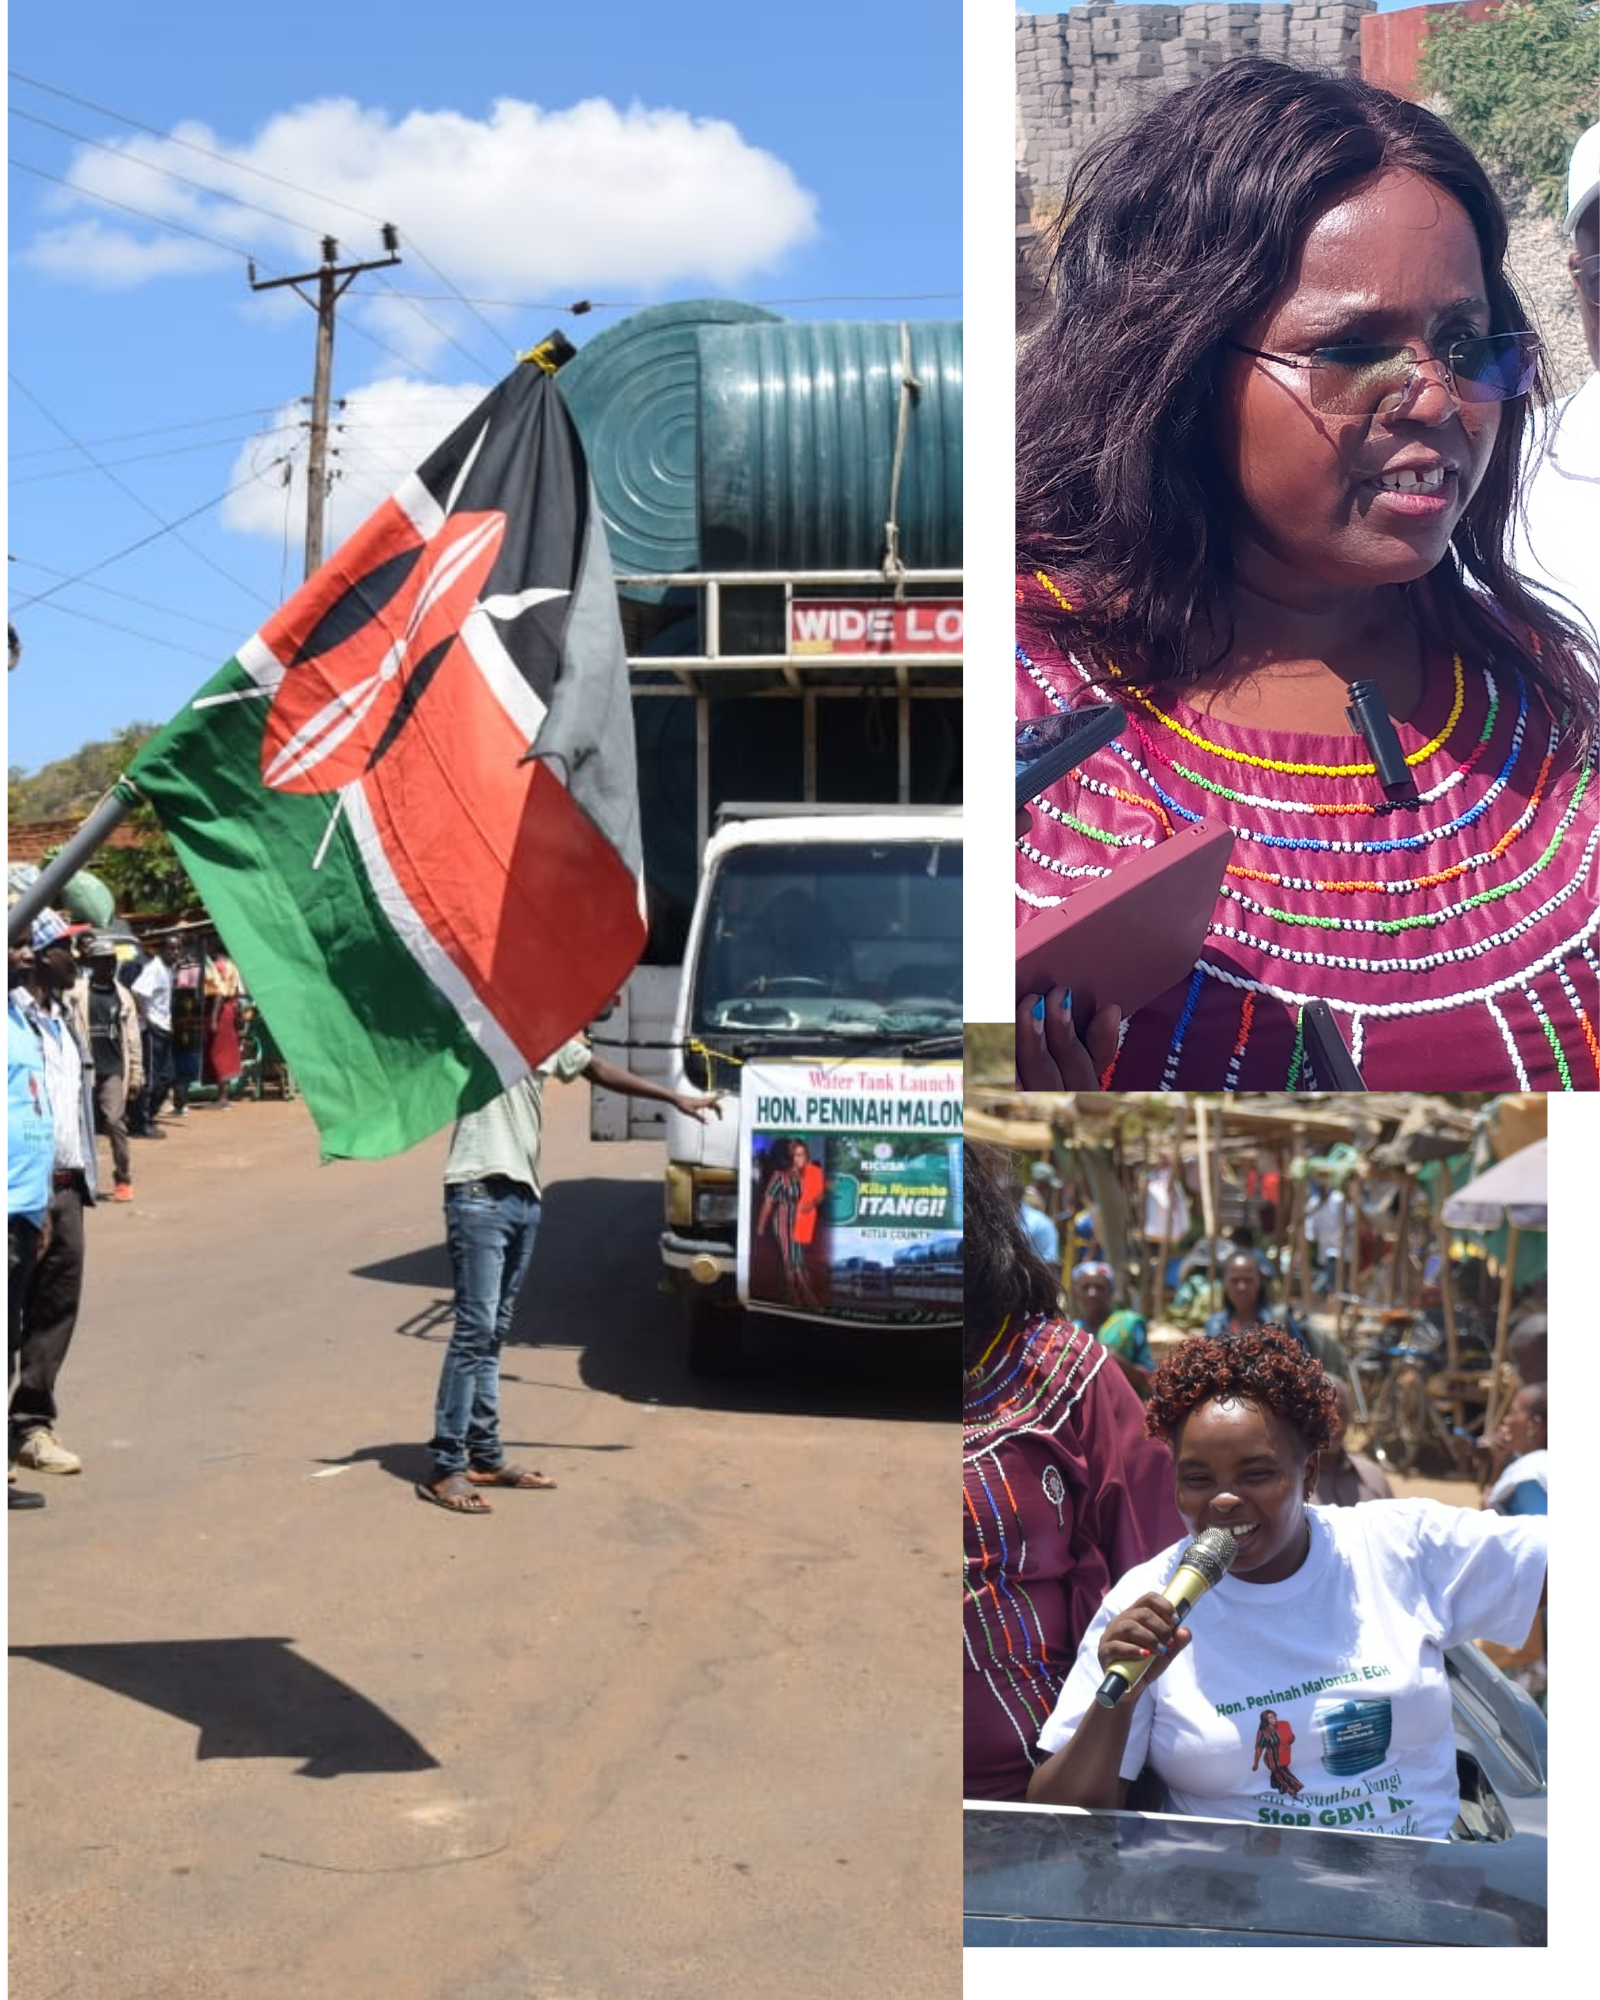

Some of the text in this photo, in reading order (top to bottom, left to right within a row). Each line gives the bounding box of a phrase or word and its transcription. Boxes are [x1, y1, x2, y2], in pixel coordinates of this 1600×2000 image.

[795, 608, 896, 641] WIDE
[809, 1071, 853, 1090] Water
[859, 1072, 894, 1091] Tank
[901, 1074, 955, 1092] Launch
[757, 1096, 963, 1127] HON. PENINAH MALON
[1215, 1665, 1392, 1718] Hon. Peninah Malonza, EGH
[1292, 1786, 1361, 1808] Nyumba
[1258, 1807, 1311, 1827] Stop
[1319, 1801, 1376, 1826] GBV!
